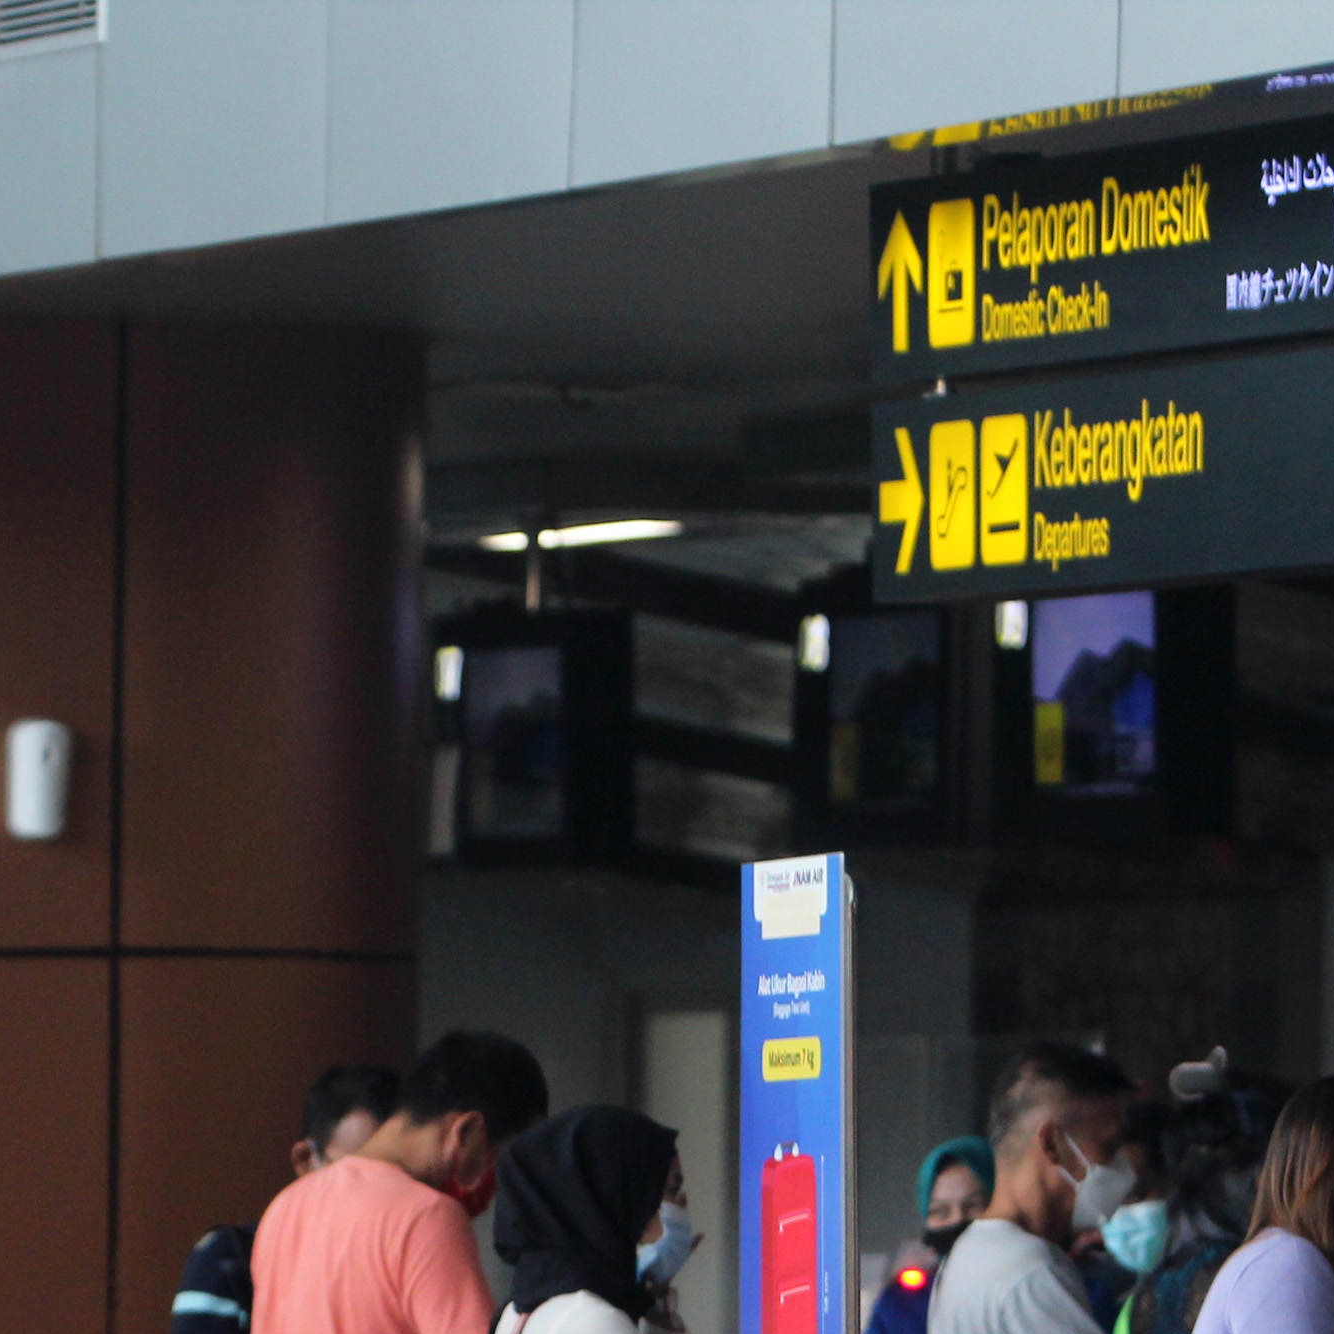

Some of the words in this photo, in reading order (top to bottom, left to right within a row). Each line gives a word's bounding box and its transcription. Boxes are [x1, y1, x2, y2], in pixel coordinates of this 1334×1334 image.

[982, 188, 1095, 281] Pelaporan
[1101, 164, 1211, 255] Domestik
[982, 287, 1044, 342] Domestic
[1047, 280, 1110, 332] Check-In
[1034, 400, 1204, 502] Keberangkatan
[1034, 513, 1110, 572] Departures
